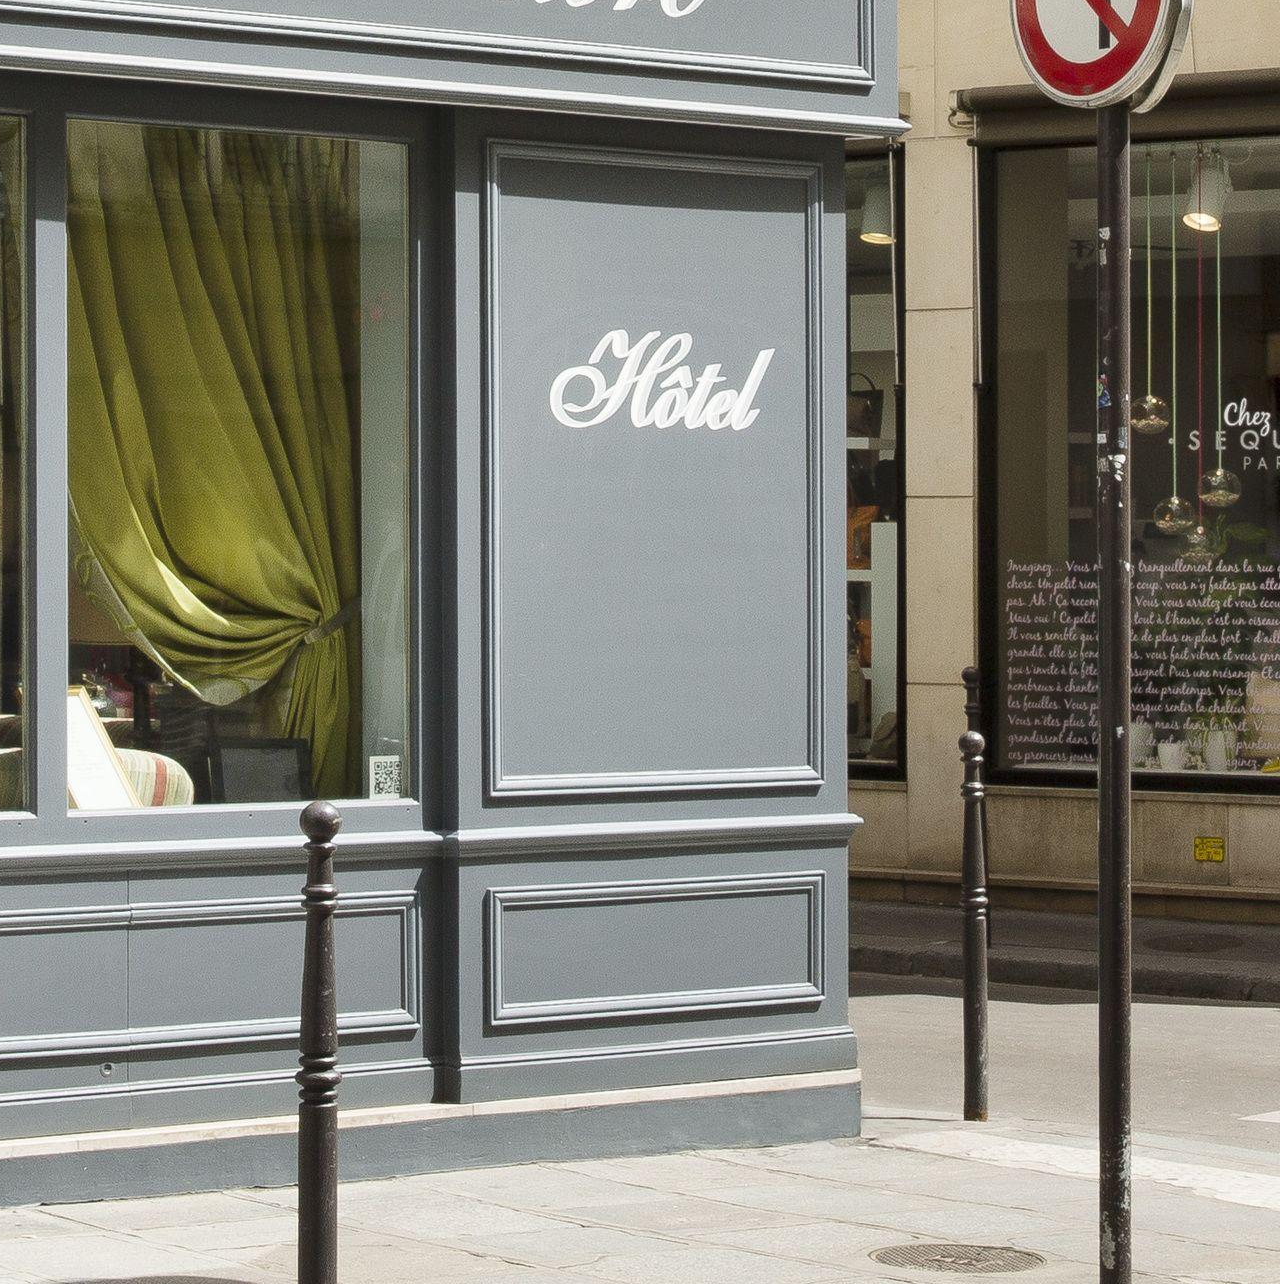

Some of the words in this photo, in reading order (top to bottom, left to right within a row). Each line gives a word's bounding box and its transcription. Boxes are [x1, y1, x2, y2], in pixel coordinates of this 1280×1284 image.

[549, 329, 776, 431] Hôtel
[1224, 397, 1270, 437] Chez
[1065, 560, 1091, 572] Vous
[1138, 559, 1212, 579] tranquillement
[1215, 559, 1240, 572] dans
[1053, 577, 1077, 595] petit
[1165, 581, 1188, 590] vous
[1209, 576, 1237, 593] faites
[1239, 581, 1258, 597] pas
[1135, 596, 1160, 607] Vous
[1162, 598, 1185, 607] vous
[1186, 596, 1221, 613] arrêtez
[1235, 599, 1258, 608] vous
[1072, 611, 1096, 630] petit
[1134, 611, 1155, 625] tout
[1248, 616, 1280, 626] oiseau
[1021, 632, 1041, 640] vous
[1045, 627, 1077, 641] semble
[1155, 628, 1179, 648] plus
[1194, 628, 1218, 648] plus
[1220, 629, 1240, 646] fort
